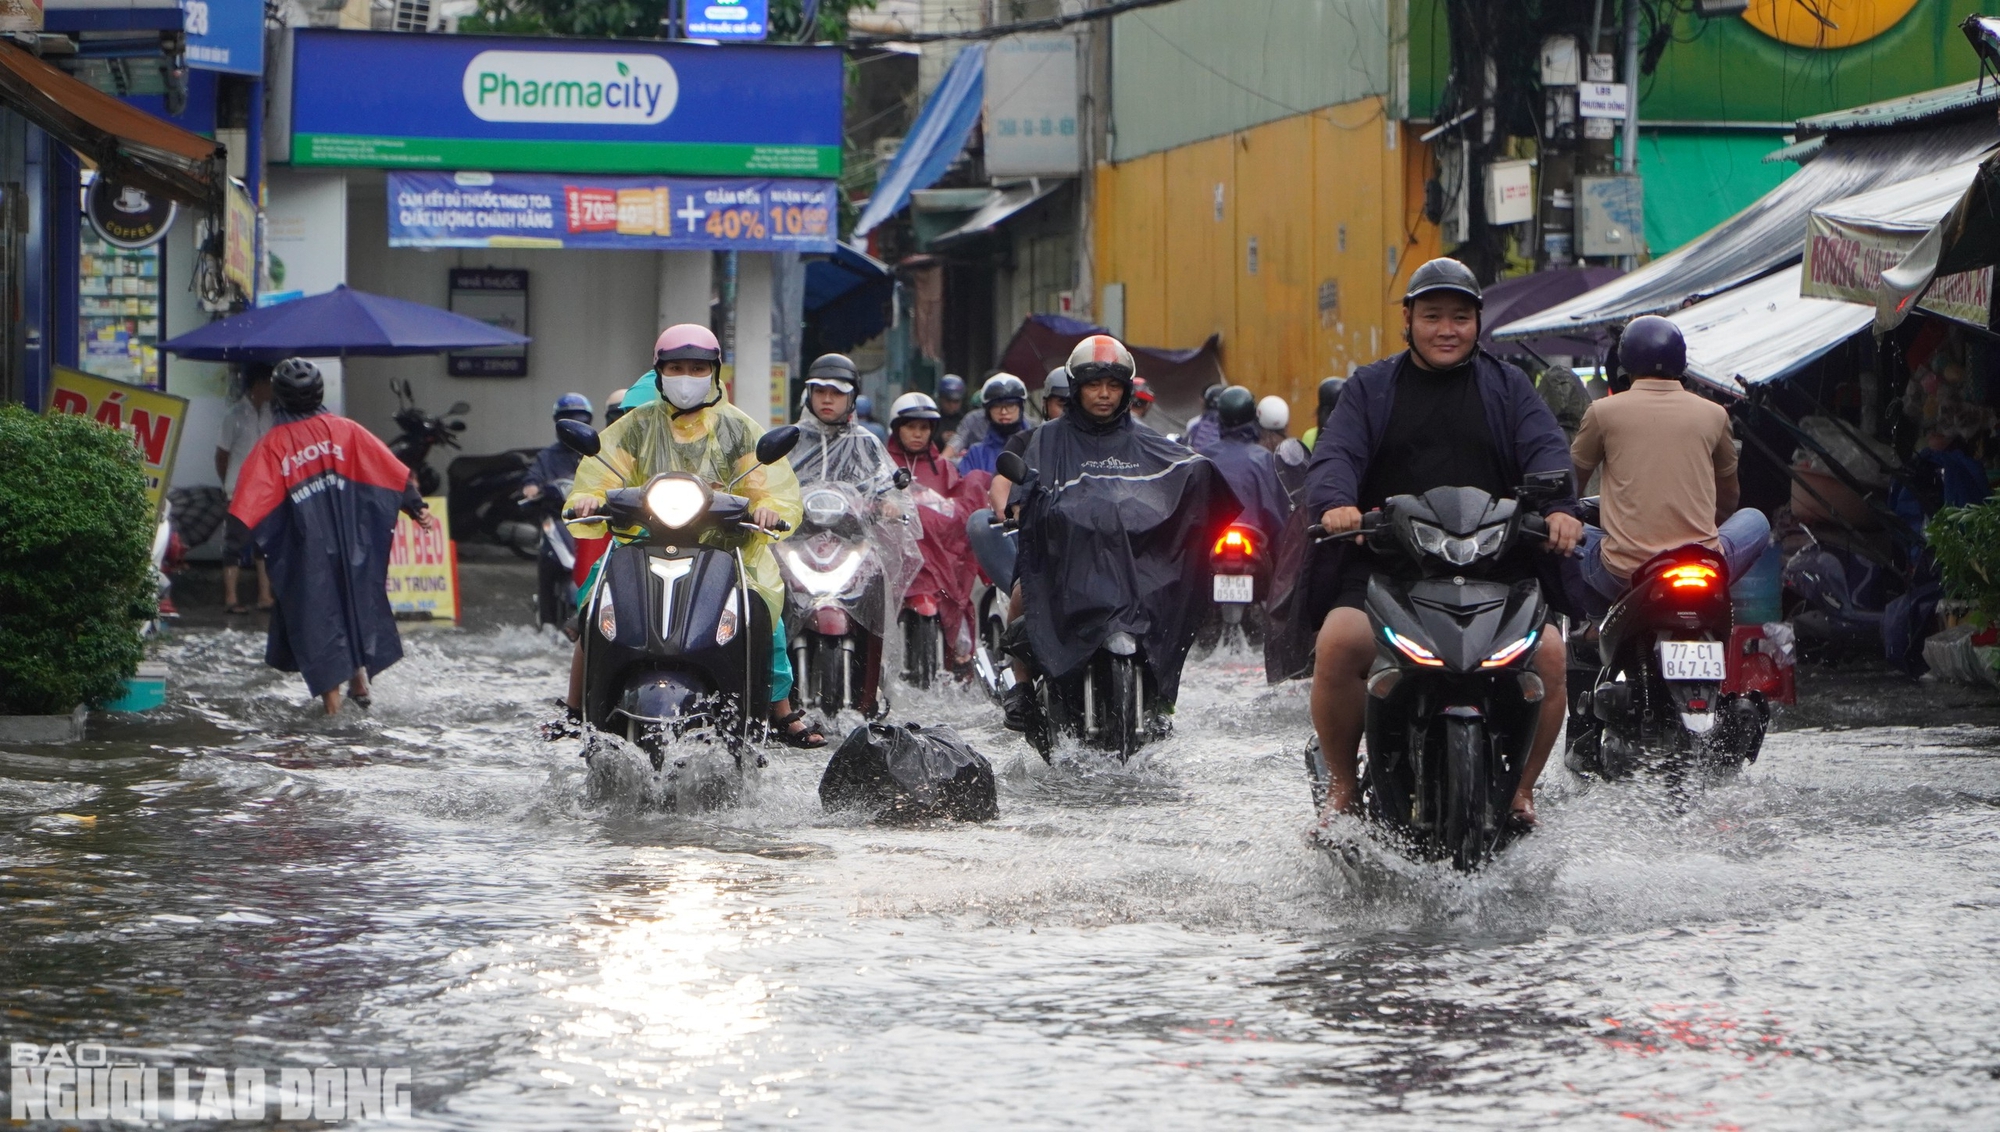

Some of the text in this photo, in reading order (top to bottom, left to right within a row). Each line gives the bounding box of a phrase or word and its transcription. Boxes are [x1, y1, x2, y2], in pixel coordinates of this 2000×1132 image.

[479, 63, 662, 117] Pharmacity
[529, 194, 552, 209] TOA
[106, 221, 154, 238] COFFEE
[705, 209, 765, 239] 40%
[405, 575, 446, 592] TRUNG
[1671, 643, 1713, 660] 77-C1
[1666, 661, 1722, 677] 847.43
